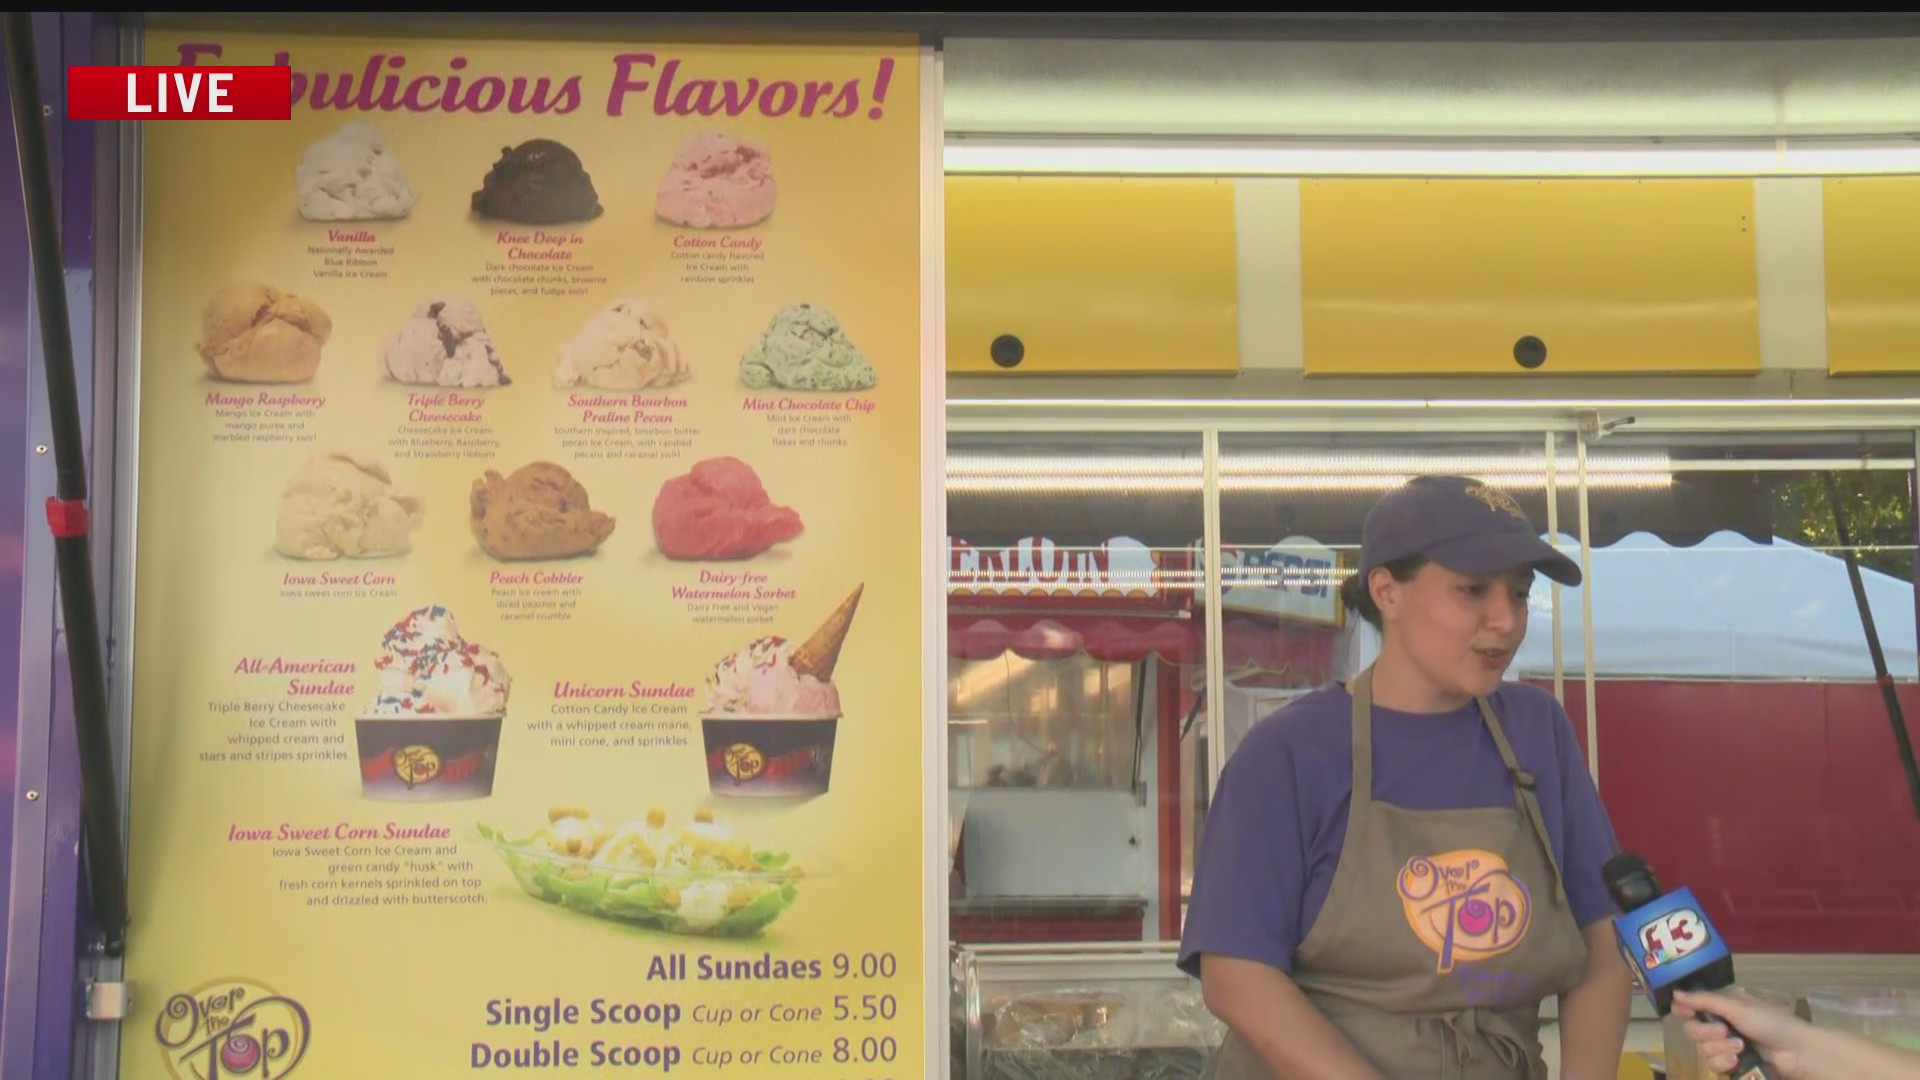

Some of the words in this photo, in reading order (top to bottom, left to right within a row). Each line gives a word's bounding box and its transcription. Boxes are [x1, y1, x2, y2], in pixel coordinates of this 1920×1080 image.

[177, 43, 582, 117] bulicious
[606, 53, 895, 120] Flavors!
[328, 229, 376, 243] Vanilla
[497, 231, 530, 244] Knee
[533, 230, 567, 248] Deep
[569, 233, 584, 244] in
[673, 235, 717, 248] Cotton
[720, 235, 763, 250] Candy
[307, 246, 353, 258] Nationally
[354, 246, 395, 256] Awarded
[508, 246, 572, 260] Chocolate
[670, 251, 700, 260] Cotton
[702, 251, 728, 262] candy
[729, 250, 765, 261] flavored
[324, 256, 344, 266] Blue
[346, 258, 378, 267] Ribbon
[485, 262, 506, 272] Dark
[508, 263, 550, 272] chocolate
[551, 264, 564, 272] Ice
[566, 263, 594, 272] Cream
[686, 262, 698, 271] Ice
[700, 262, 728, 272] Cream
[729, 264, 749, 272] with
[312, 269, 344, 278] Vanilla
[345, 270, 358, 278] Ice
[359, 269, 388, 279] Cream
[471, 274, 492, 283] with
[492, 274, 535, 284] chocolate
[536, 275, 569, 284] chunks,
[571, 275, 608, 284] brownie
[680, 274, 716, 284] rainbow
[490, 287, 519, 296] pieces,
[521, 286, 538, 295] and
[540, 286, 566, 297] fudge
[568, 287, 588, 296] swirl
[205, 392, 254, 408] Mango
[258, 392, 326, 410] Raspberry
[408, 393, 445, 409] Triple
[448, 393, 485, 410] Berry
[568, 394, 628, 407] Southern
[631, 394, 688, 408] Bourbon
[743, 397, 776, 411] Mint
[778, 397, 842, 411] Chocolate
[845, 397, 876, 414] Chip
[215, 408, 248, 419] Mango
[249, 409, 262, 418] Ice
[264, 409, 293, 418] Cream
[294, 408, 318, 418] with
[408, 408, 482, 422] Cheesecake
[582, 410, 630, 423] Praline
[634, 410, 673, 424] Pecan
[225, 422, 258, 432] mango
[259, 422, 285, 431] puree
[288, 420, 305, 430] and
[212, 433, 250, 442] marbled
[252, 432, 295, 444] raspberry
[296, 432, 317, 443] swirl
[283, 572, 317, 586] Iowa
[319, 571, 360, 585] Sweet
[362, 571, 395, 586] Corn
[490, 570, 529, 584] Peach
[533, 570, 584, 585] Cobbler
[699, 570, 768, 586] Dairy-free
[1243, 551, 1331, 598] PEPSI
[280, 589, 302, 598] Iowa
[304, 586, 331, 598] sweet
[332, 590, 353, 598] corn
[354, 588, 369, 599] Ice
[369, 586, 398, 598] Cream
[672, 584, 751, 599] Watermelon
[754, 586, 796, 600] Sorbet
[234, 656, 356, 674] All-American
[287, 678, 354, 696] Sundae
[554, 681, 626, 699] Unicorn
[628, 681, 695, 698] Sundae
[208, 701, 240, 714] Triple
[244, 701, 275, 714] Berry
[278, 700, 346, 712] Cheesecake
[550, 704, 590, 715] Cotton
[593, 703, 629, 716] Candy
[632, 703, 648, 714] Ice
[650, 703, 687, 714] Cream
[249, 718, 266, 728] Ice
[269, 717, 307, 728] Cream
[310, 716, 336, 728] with
[526, 720, 553, 731] with
[556, 722, 563, 730] a
[566, 719, 616, 733] whipped
[619, 722, 654, 730] cream
[227, 733, 280, 747] whipped
[283, 735, 319, 744] cream
[322, 732, 345, 744] and
[550, 736, 576, 747] mini
[578, 738, 609, 747] cone,
[613, 735, 634, 746] and
[199, 752, 226, 762] stars
[229, 750, 252, 761] and
[255, 750, 294, 763] stripes
[228, 824, 273, 842] Iowa
[276, 823, 331, 841] Sweet
[334, 823, 380, 840] Corn
[383, 822, 451, 840] Sundae
[272, 847, 301, 858] Iowa
[304, 846, 340, 857] Sweet
[344, 844, 372, 856] Corn
[375, 846, 391, 856] Ice
[394, 844, 432, 856] Cream
[435, 844, 457, 856] and
[328, 864, 362, 876] green
[366, 861, 400, 874] candy
[447, 860, 474, 872] with
[279, 879, 308, 890] fresh
[311, 880, 338, 890] corn
[341, 878, 383, 889] kernels
[386, 876, 440, 890] sprinkled
[442, 879, 458, 888] on
[462, 878, 482, 889] top
[1399, 856, 1480, 900] Over
[306, 895, 329, 906] and
[332, 894, 379, 906] drizzled
[382, 894, 409, 905] with
[1420, 878, 1518, 969] Top
[1648, 908, 1707, 964] 13
[646, 953, 686, 981] All
[697, 952, 822, 980] Sundaes
[832, 952, 896, 979] 9.00
[155, 987, 245, 1047] Over
[486, 997, 579, 1032] Single
[590, 998, 681, 1030] Scoop
[692, 1005, 732, 1027] Cup
[740, 1008, 762, 1022] or
[769, 1004, 822, 1022] Cone
[834, 994, 897, 1021] 5.50
[205, 1015, 230, 1034] the
[178, 1008, 292, 1080] Top
[471, 1040, 579, 1068] Double
[590, 1040, 681, 1072] Scoop
[692, 1047, 732, 1069] Cup
[740, 1051, 762, 1065] or
[769, 1046, 822, 1064] Cone
[833, 1036, 897, 1063] 8.00
